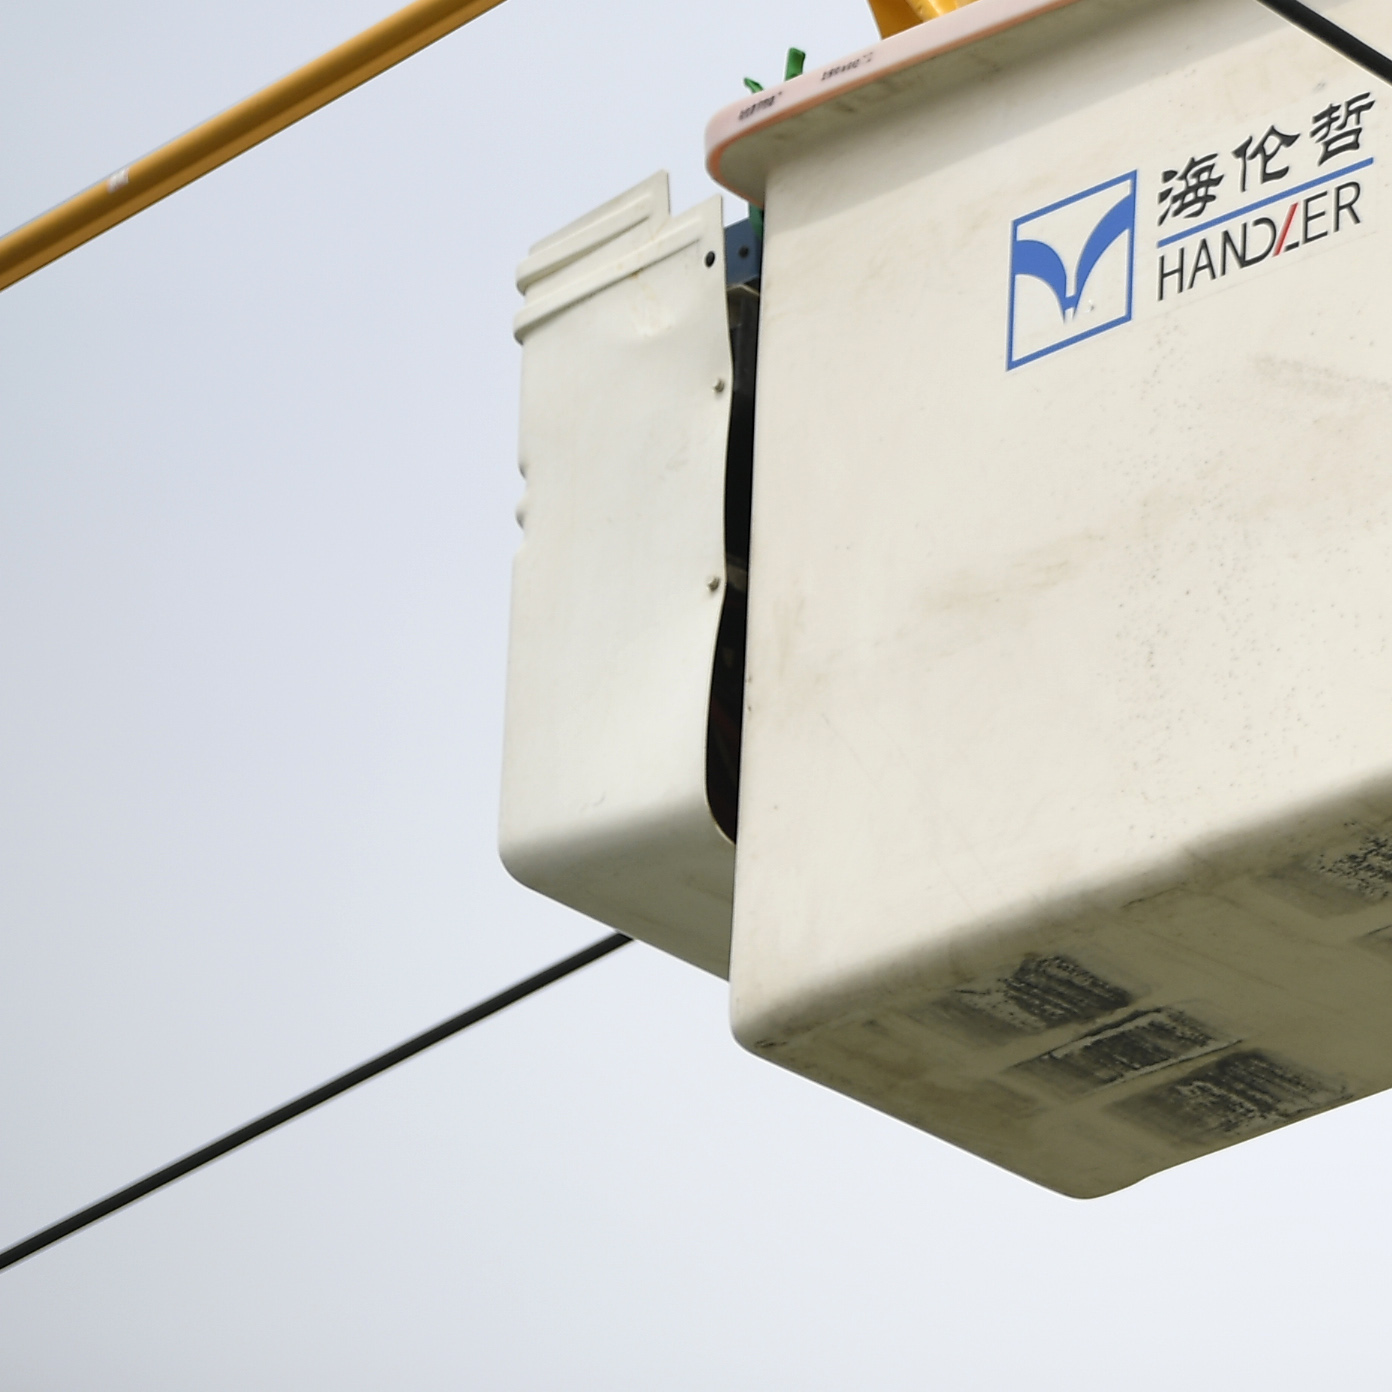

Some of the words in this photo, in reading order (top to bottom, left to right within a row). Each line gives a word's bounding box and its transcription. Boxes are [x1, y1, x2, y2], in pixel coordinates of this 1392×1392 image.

[1157, 91, 1376, 227] 海伦哲
[1157, 180, 1363, 302] HANDLER
